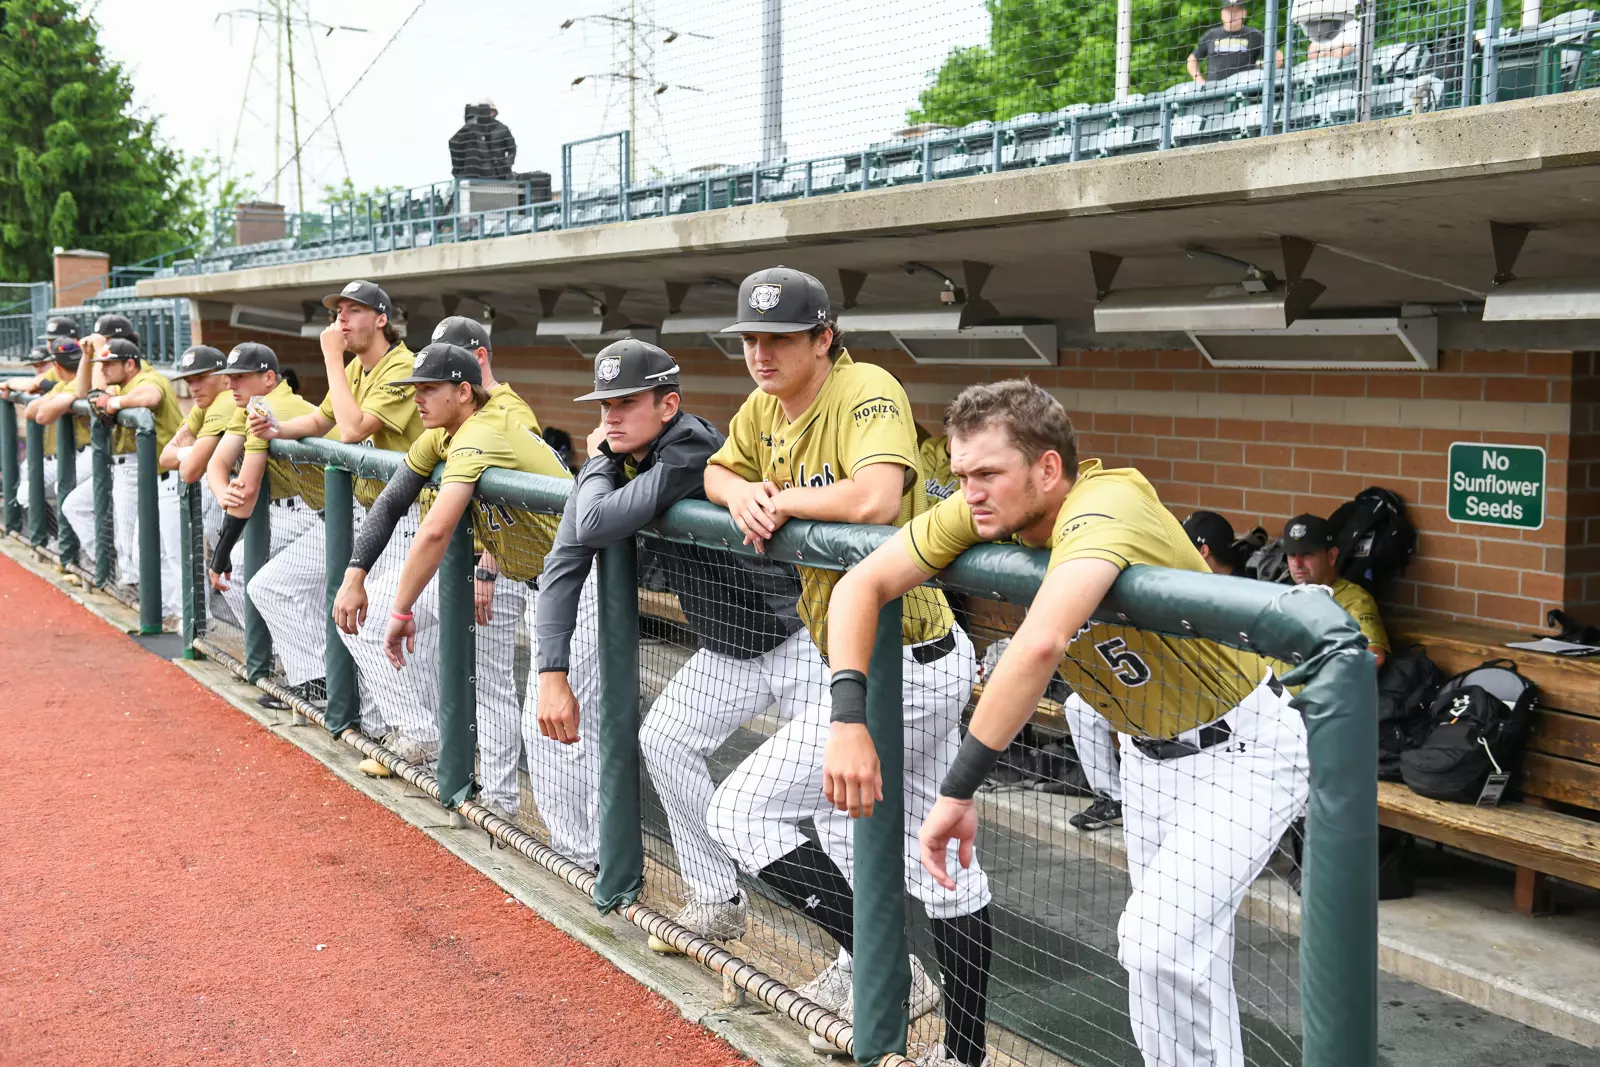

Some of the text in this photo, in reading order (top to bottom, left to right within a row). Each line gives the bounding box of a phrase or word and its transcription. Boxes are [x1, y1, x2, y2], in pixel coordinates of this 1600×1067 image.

[1482, 450, 1510, 471] No
[1453, 471, 1540, 497] Sunflower
[1465, 496, 1523, 520] Seeds
[1094, 636, 1151, 688] 5
